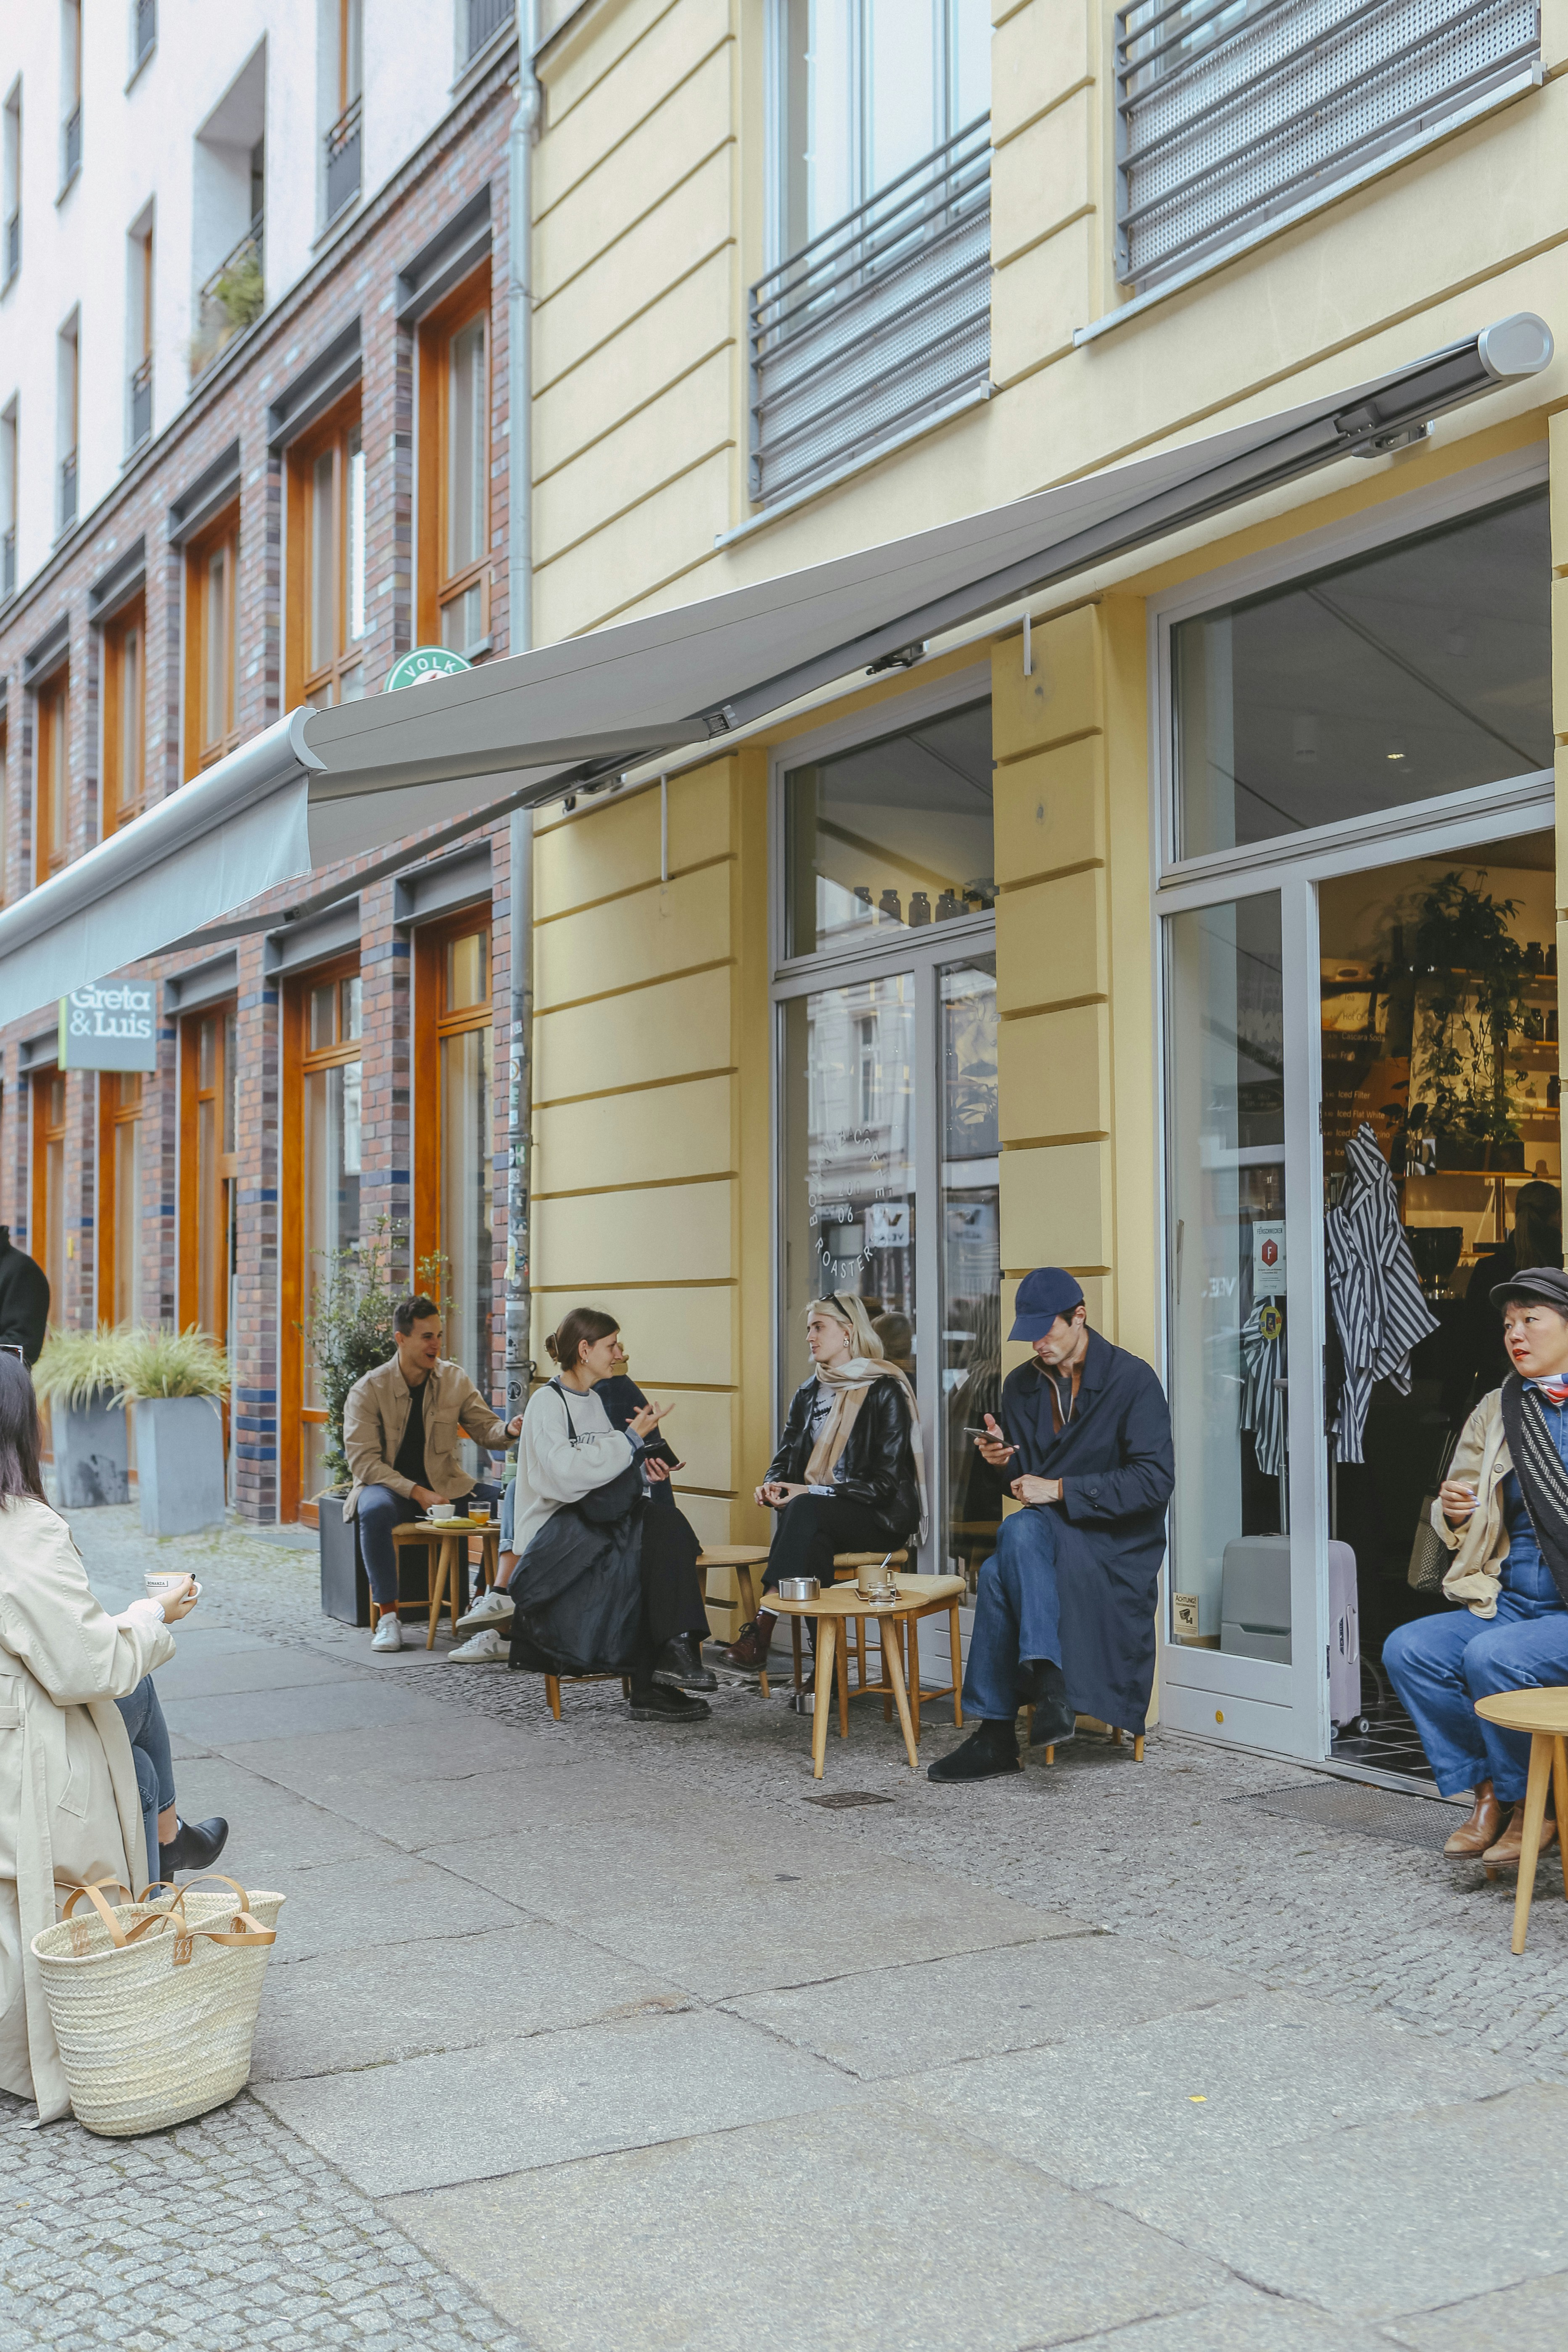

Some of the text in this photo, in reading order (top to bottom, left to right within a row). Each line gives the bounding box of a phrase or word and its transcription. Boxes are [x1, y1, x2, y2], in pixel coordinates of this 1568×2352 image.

[404, 656, 456, 677] VOLK
[69, 983, 150, 1011] Greta
[70, 1010, 151, 1039] & Luis
[1342, 1032, 1367, 1041] Cascara
[1370, 1033, 1385, 1042] Soda
[1338, 1090, 1352, 1098] Iced
[1354, 1090, 1370, 1099] Filter
[1367, 1111, 1385, 1119] White
[838, 1206, 853, 1223] 06
[1267, 1246, 1272, 1260] F
[1175, 1594, 1196, 1604] ACHTUNG!
